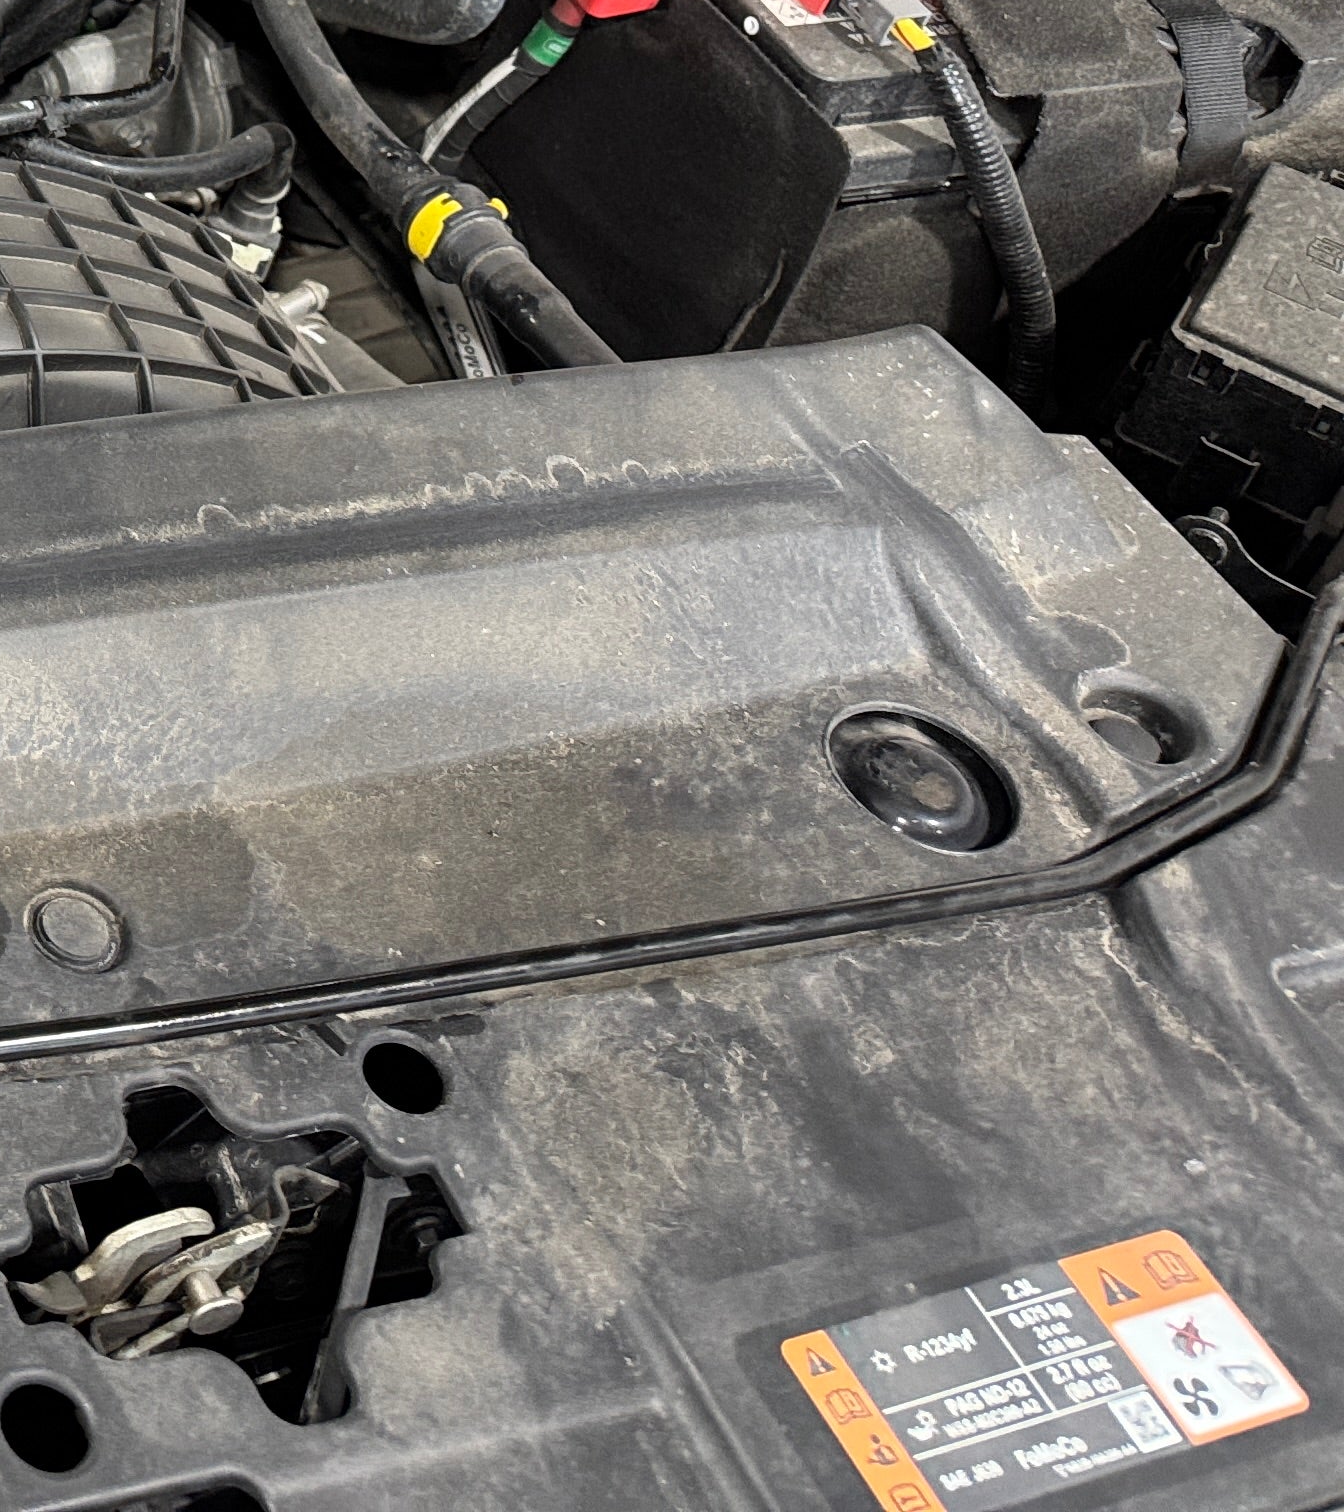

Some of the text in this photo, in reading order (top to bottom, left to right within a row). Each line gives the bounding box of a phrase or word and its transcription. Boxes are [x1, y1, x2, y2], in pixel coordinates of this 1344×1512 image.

[903, 1327, 978, 1363] R-1234yf
[943, 1391, 986, 1417] PAG
[1013, 1436, 1089, 1470] FoMoCo
